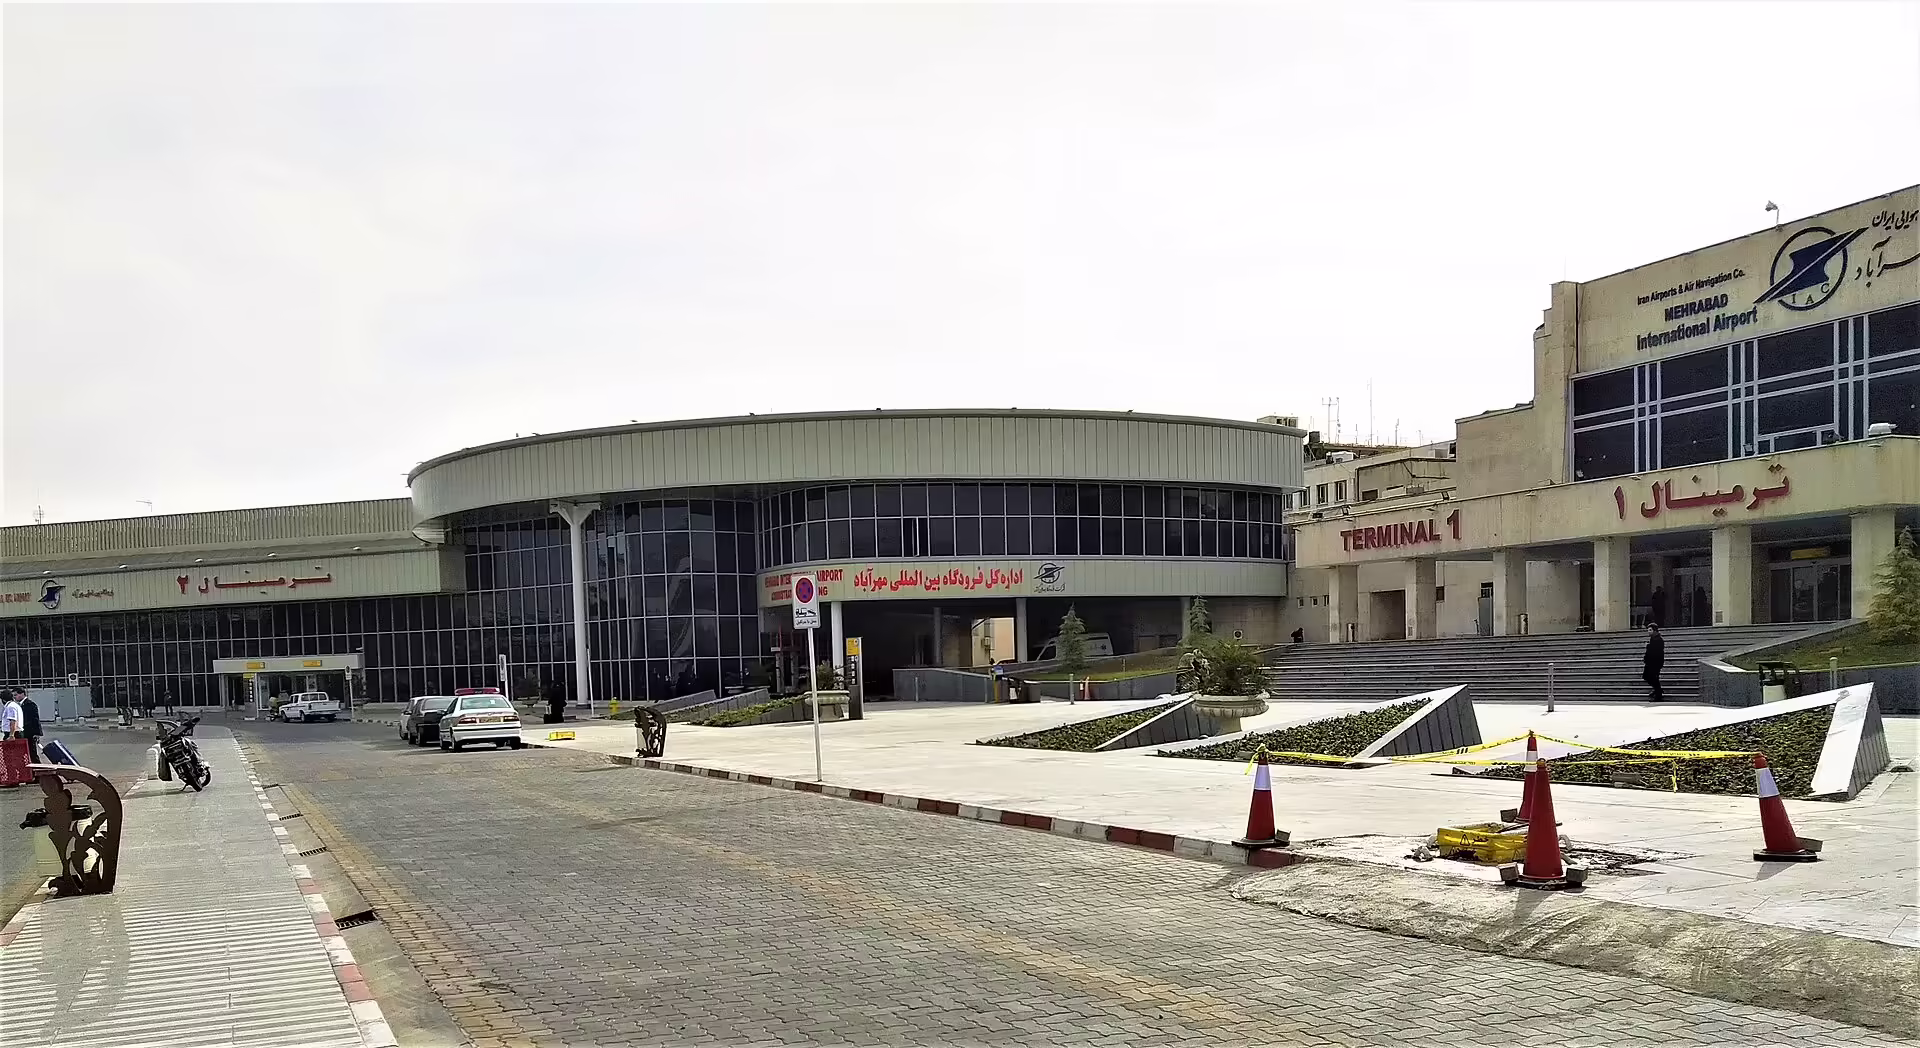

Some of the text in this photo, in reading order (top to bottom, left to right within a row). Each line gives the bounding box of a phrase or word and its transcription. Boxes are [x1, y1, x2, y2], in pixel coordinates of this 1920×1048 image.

[1871, 210, 1896, 231] ایران
[1854, 235, 1920, 288] رآباد
[1637, 268, 1746, 306] Iran Airports & Air Navigation Co.
[1664, 293, 1729, 322] MEHRABAD
[1636, 305, 1758, 351] International Airport
[1640, 462, 1791, 519] ترمینال
[1340, 508, 1462, 552] TERMINAL 1
[854, 567, 888, 593] مهرآباد
[889, 569, 923, 592] المللی
[924, 573, 940, 592] بین
[943, 566, 984, 591] فرودگاه
[1001, 567, 1023, 590] اداره
